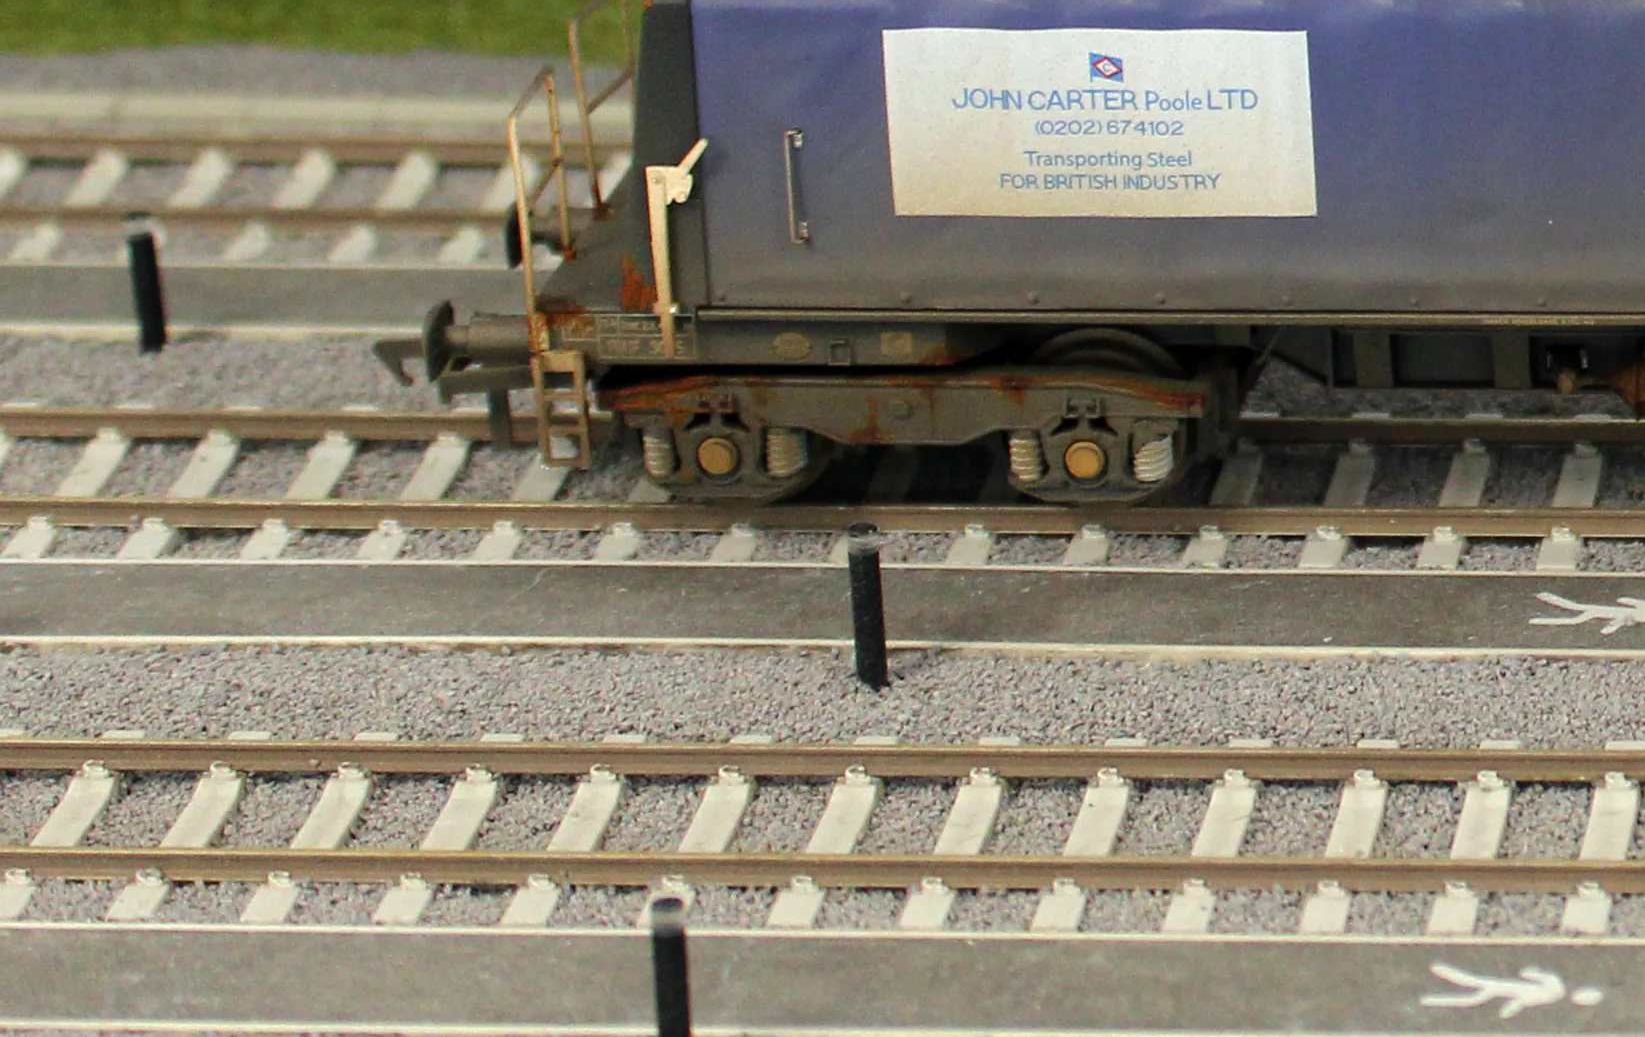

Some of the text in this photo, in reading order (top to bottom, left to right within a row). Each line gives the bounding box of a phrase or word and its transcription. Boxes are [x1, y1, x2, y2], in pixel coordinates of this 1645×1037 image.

[952, 88, 1258, 112] JOHN CARTER Poole LTD
[1034, 119, 1184, 136] (0202) 674102
[1023, 150, 1193, 172] Transporting Steel
[999, 173, 1221, 191] FOR BRITISH INDUSTRY
